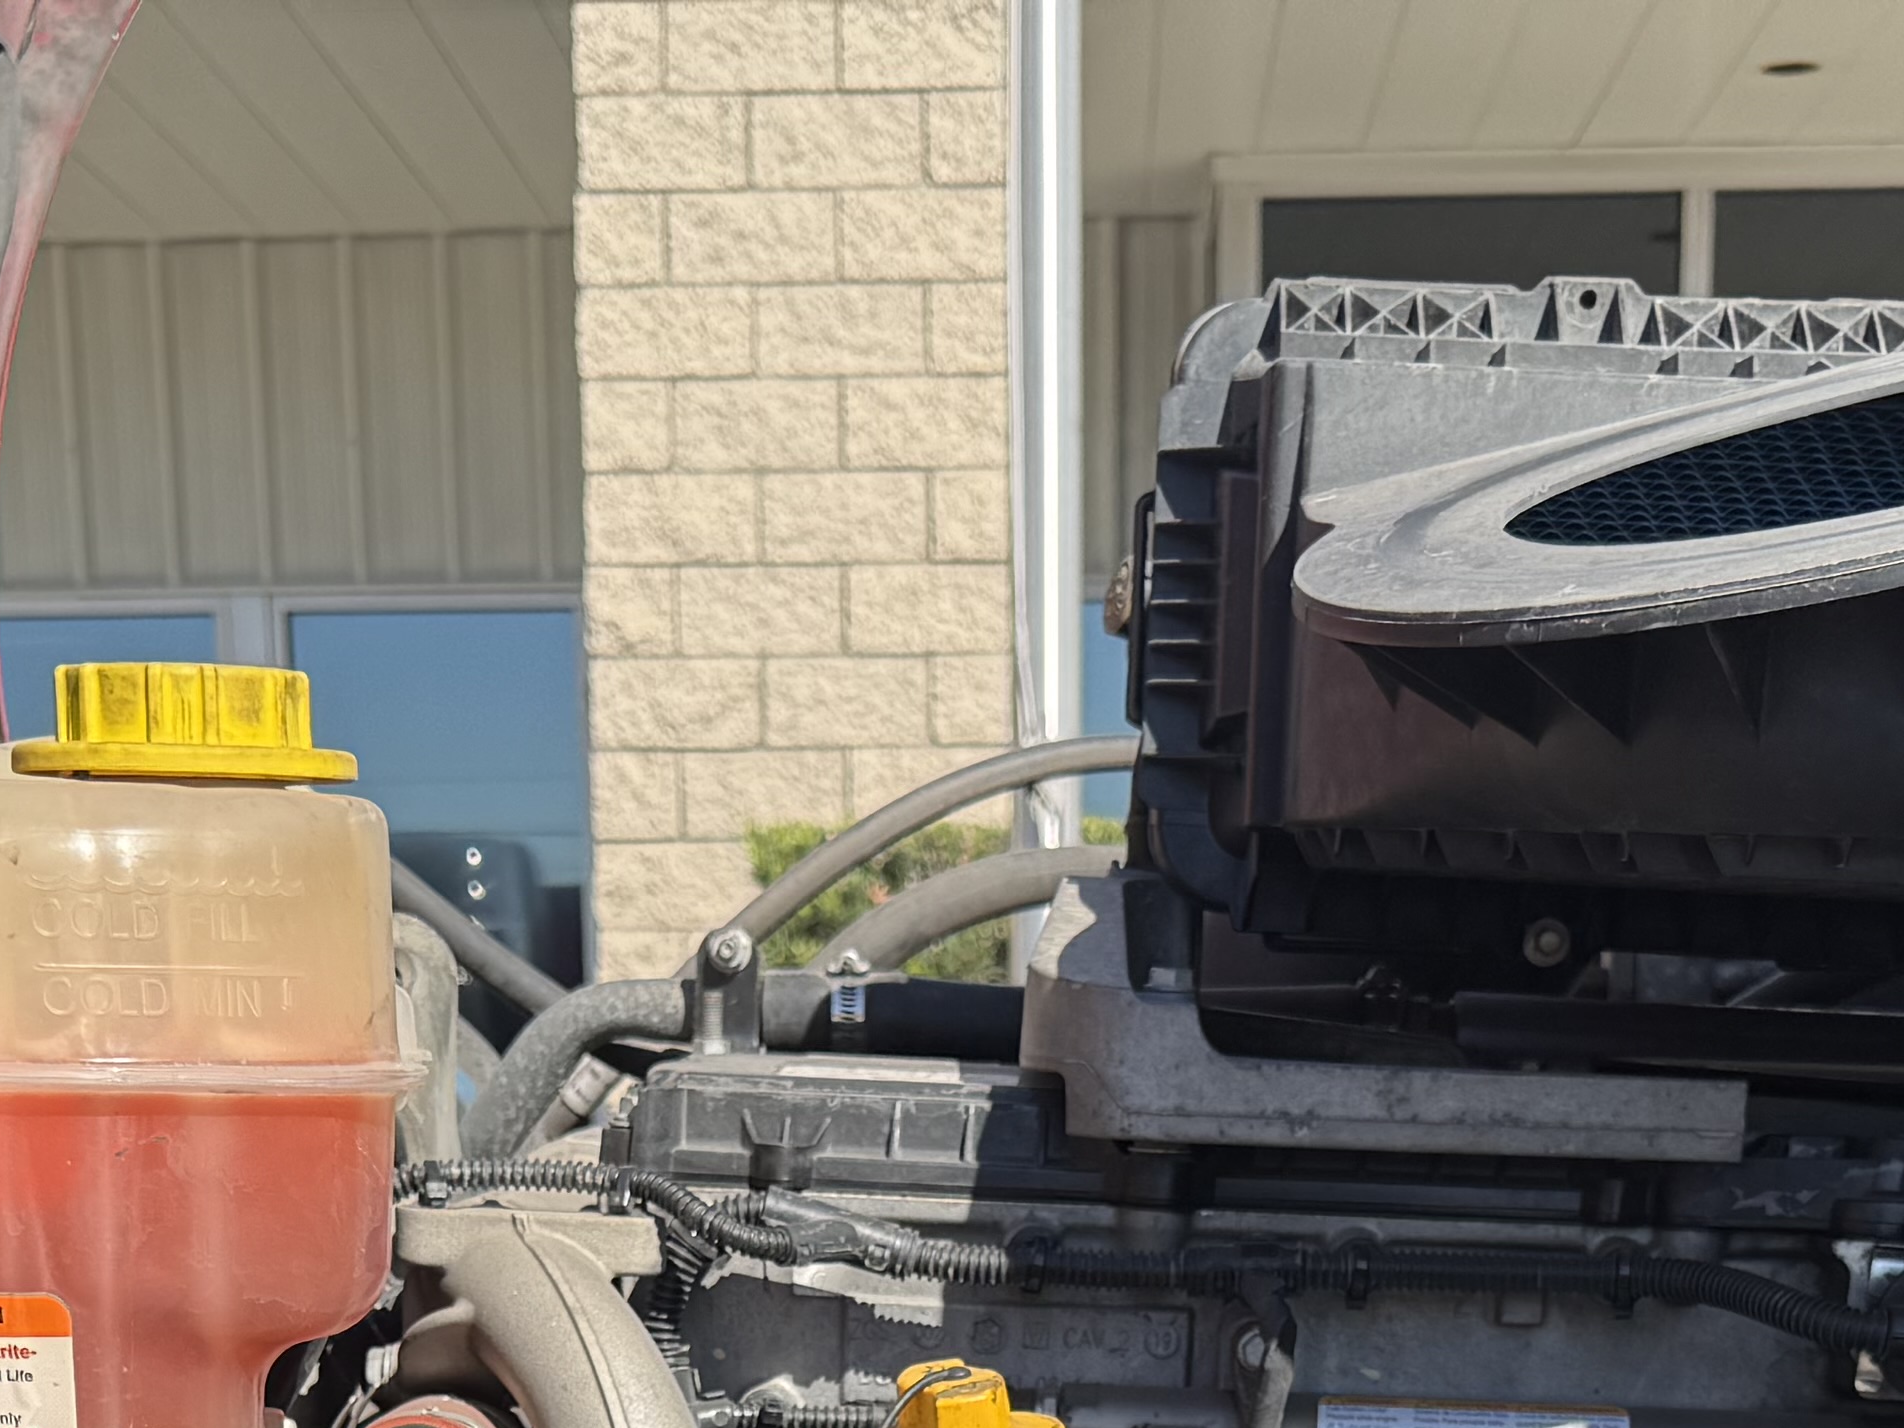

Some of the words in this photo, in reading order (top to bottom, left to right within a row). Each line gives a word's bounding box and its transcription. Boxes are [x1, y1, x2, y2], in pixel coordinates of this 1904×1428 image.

[32, 898, 160, 940] COLD
[190, 902, 263, 942] FILL
[43, 975, 171, 1017] COLD
[194, 976, 263, 1018] MIN
[5, 1369, 34, 1383] Life
